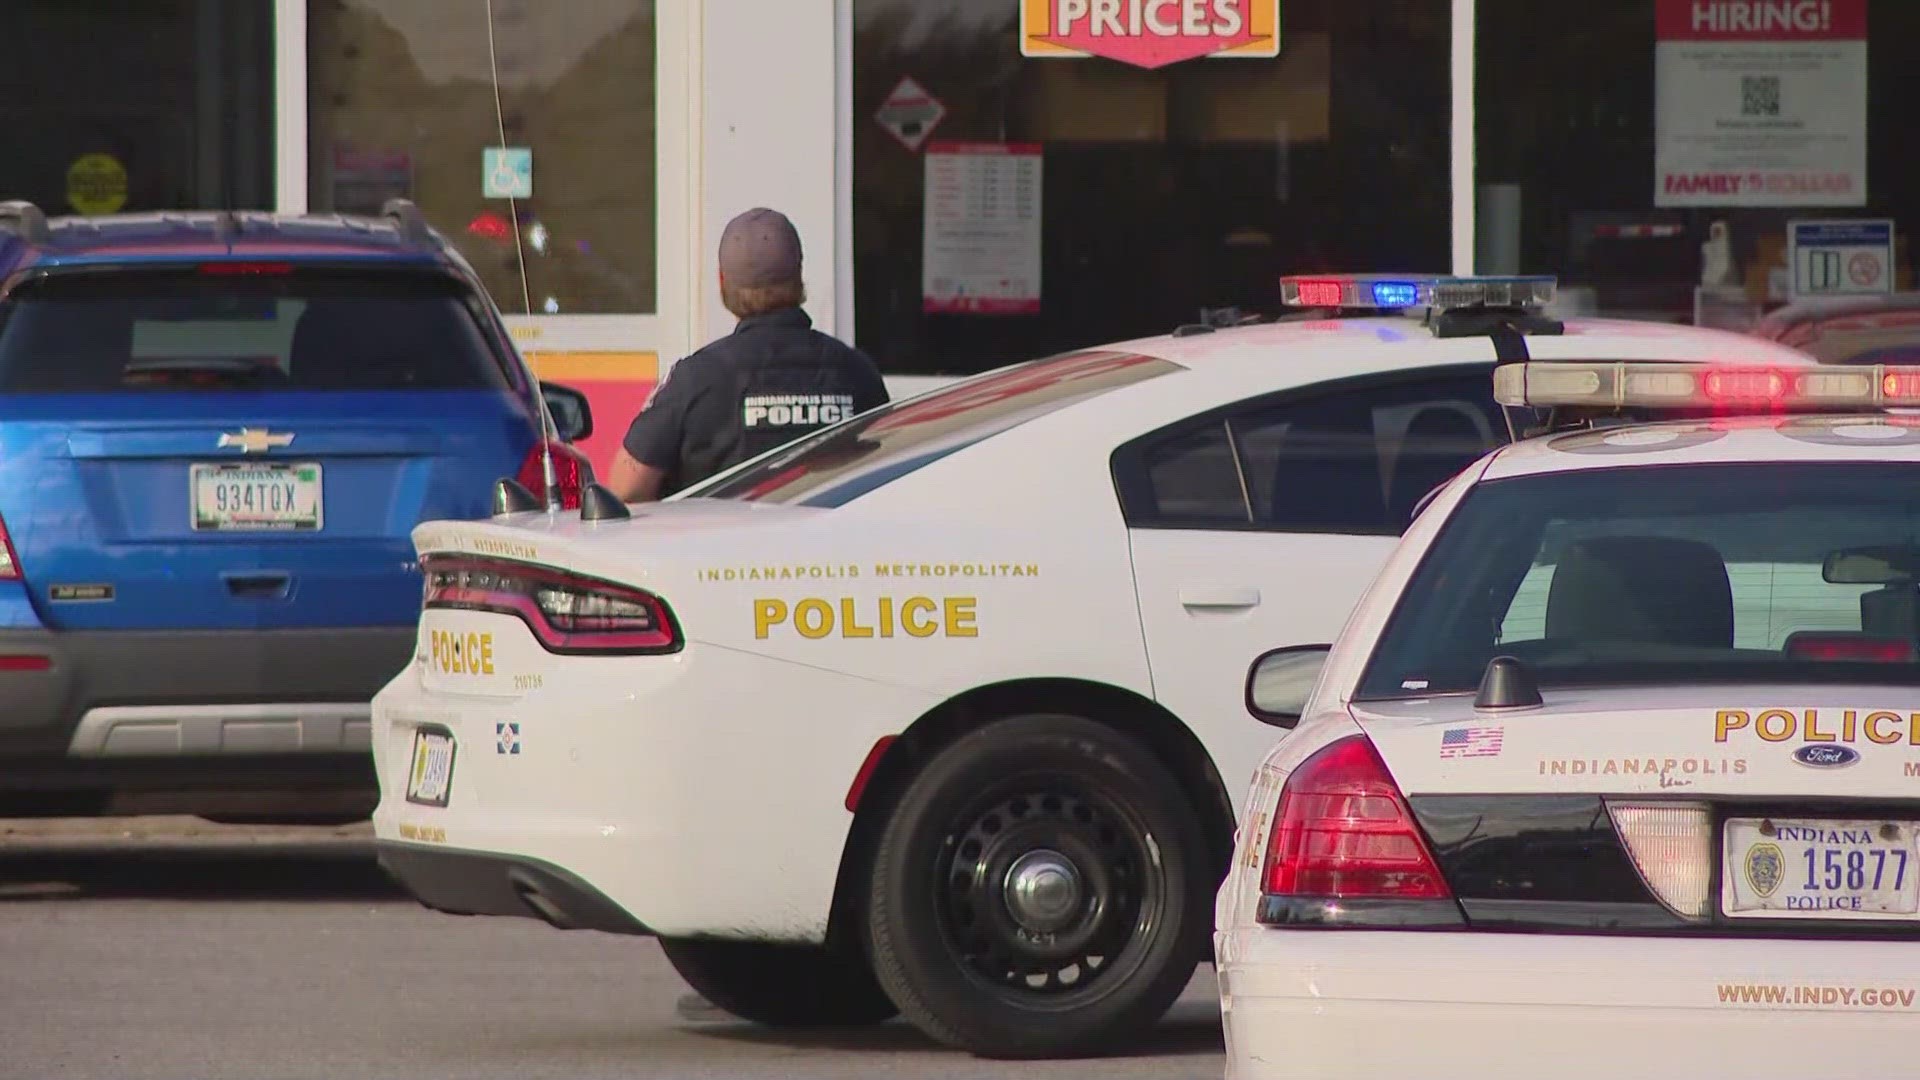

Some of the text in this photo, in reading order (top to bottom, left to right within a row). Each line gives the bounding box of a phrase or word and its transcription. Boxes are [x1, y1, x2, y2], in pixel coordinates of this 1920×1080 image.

[1057, 0, 1242, 37] PRICES
[1691, 1, 1830, 32] HIRING!
[1664, 172, 1742, 195] FAMILY
[744, 404, 855, 426] POLICE
[225, 470, 284, 480] INDIANA
[698, 563, 1040, 582] INDIANAPOLIS METROPOLITAN
[753, 596, 979, 640] POLICE
[431, 629, 494, 675] POLICE
[1806, 746, 1843, 763] Ford
[1539, 758, 1748, 776] INDIANAPOLIS
[1776, 826, 1873, 844] INDIANA
[1803, 849, 1907, 890] 15877
[1786, 895, 1862, 911] POLICE
[1717, 984, 1916, 1008] WWW.INDY.GOV
